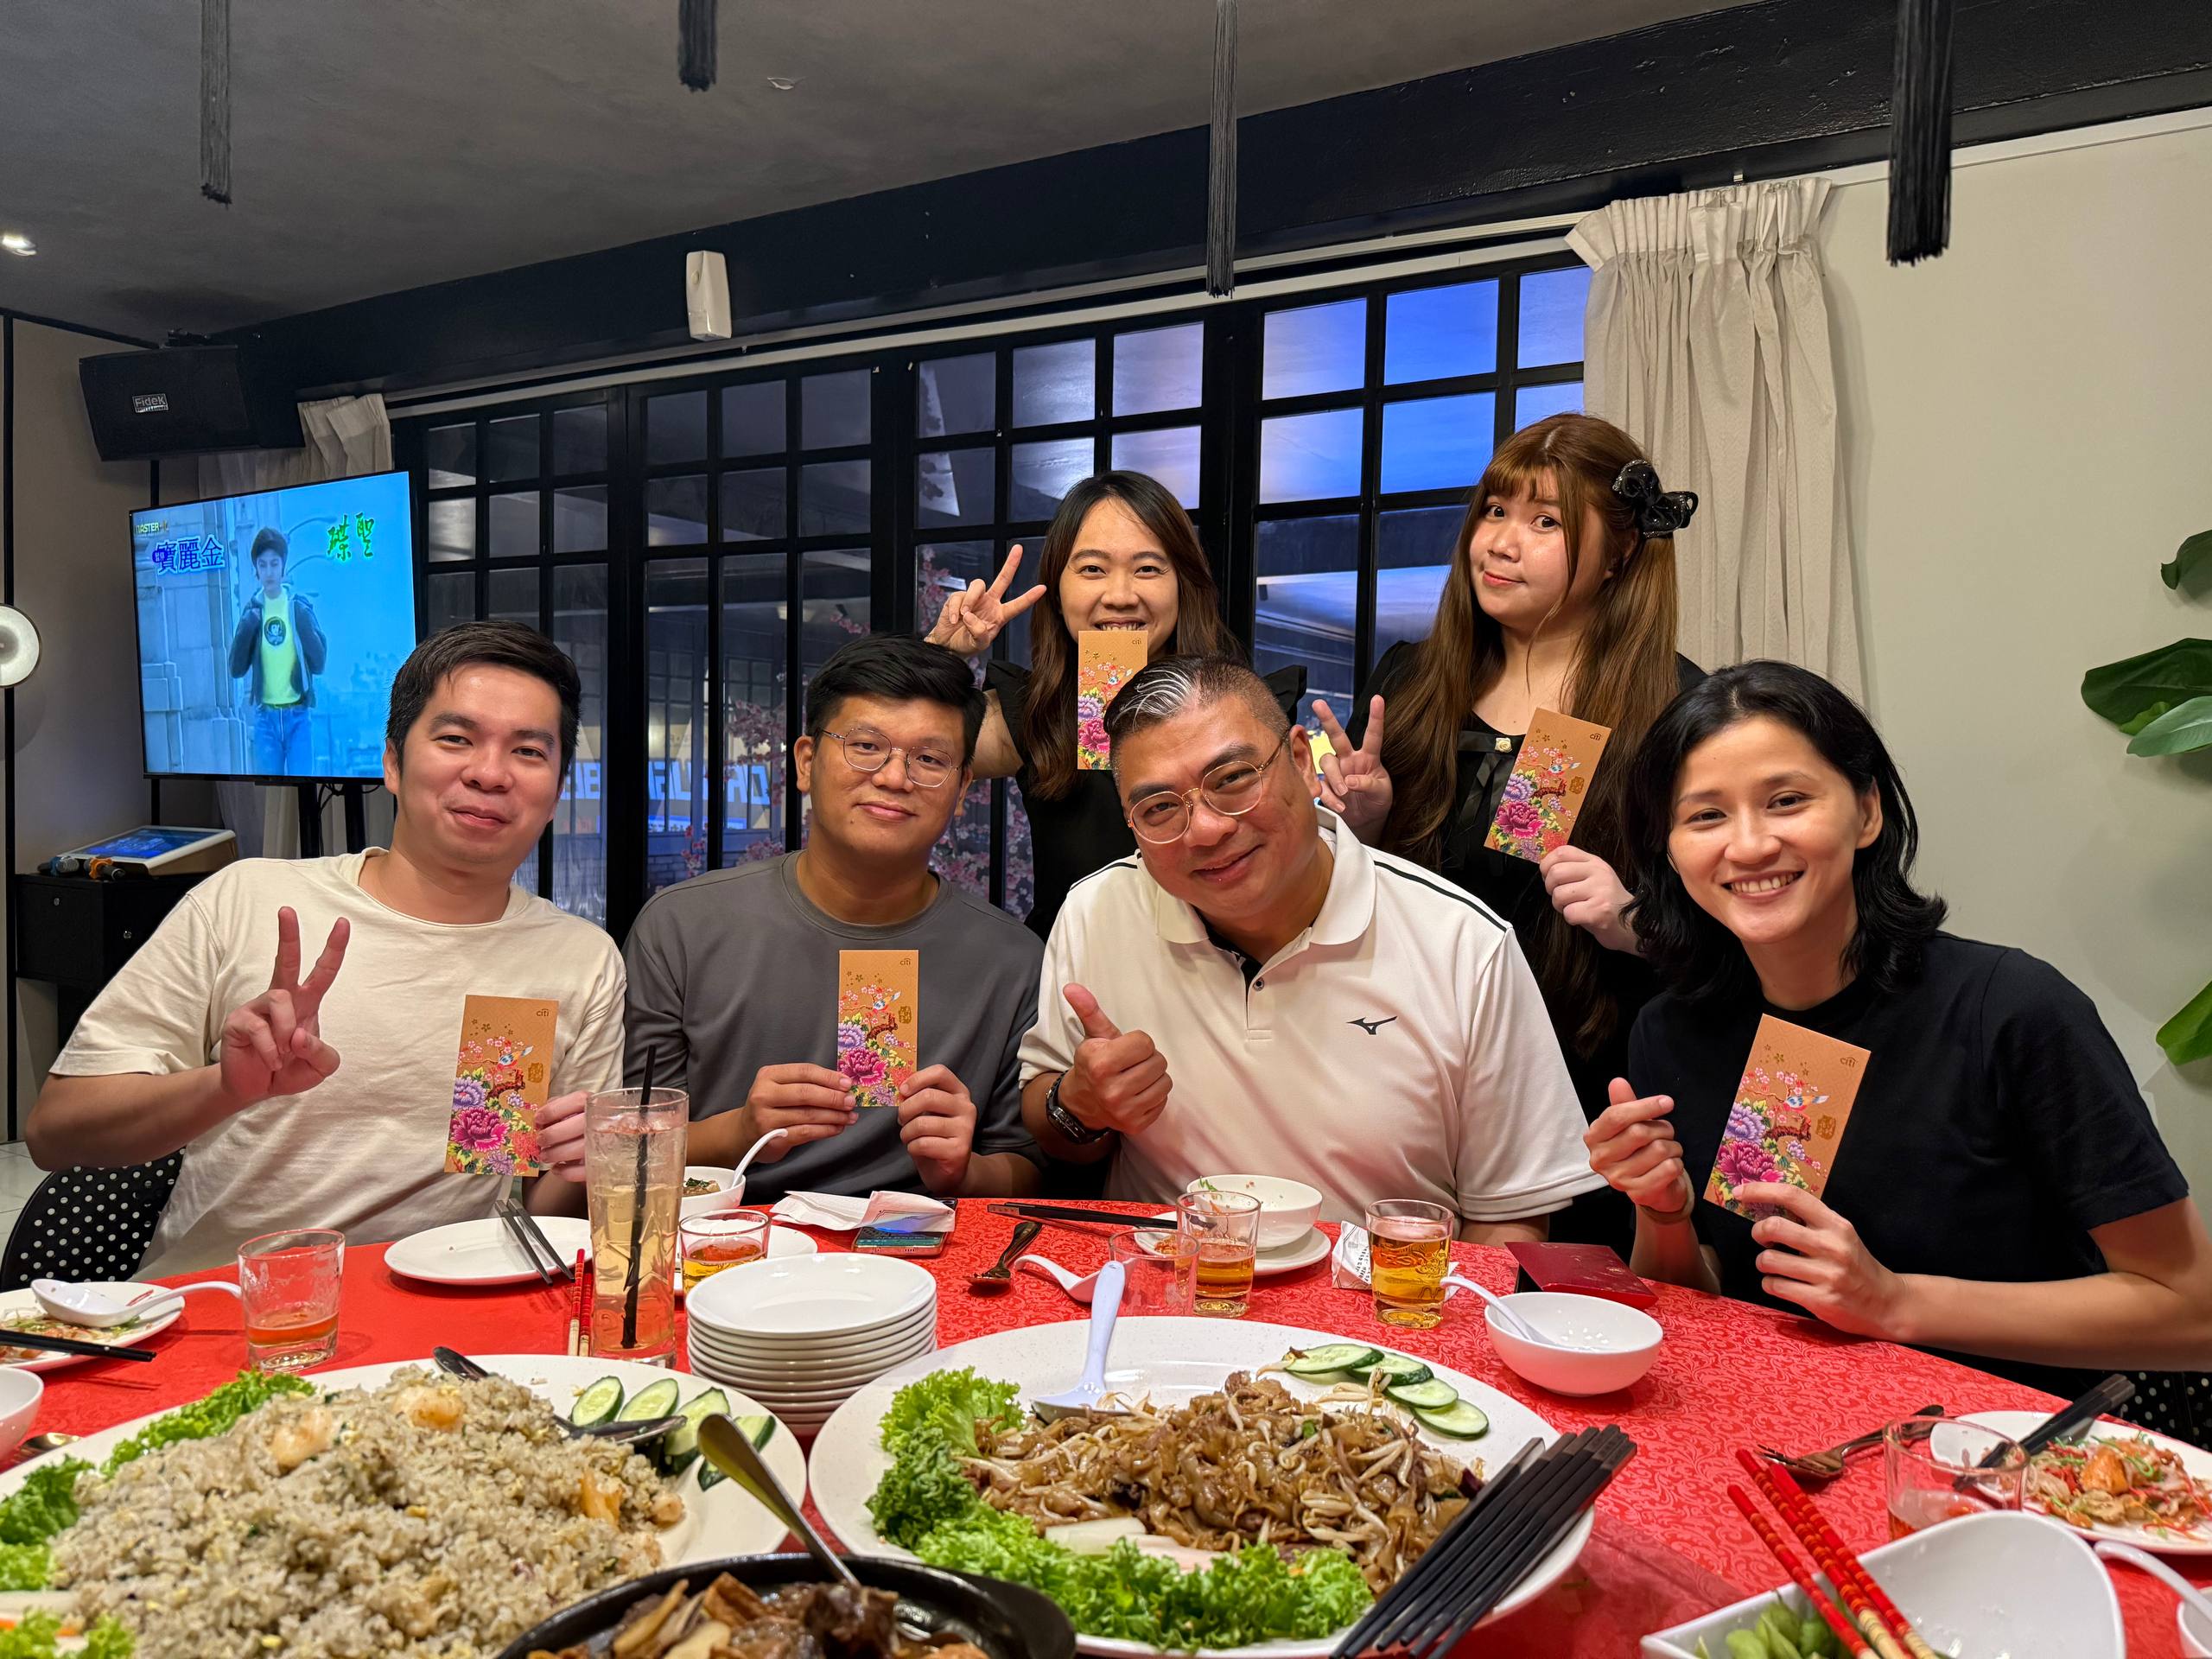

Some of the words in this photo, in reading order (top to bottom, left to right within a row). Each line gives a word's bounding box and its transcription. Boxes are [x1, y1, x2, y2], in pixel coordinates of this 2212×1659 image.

[135, 397, 166, 407] Fidek
[157, 537, 224, 573] 寶麗金
[1589, 733, 1602, 741] citi
[899, 957, 912, 966] citi
[536, 1007, 550, 1017] citi
[1840, 1056, 1857, 1068] citi
